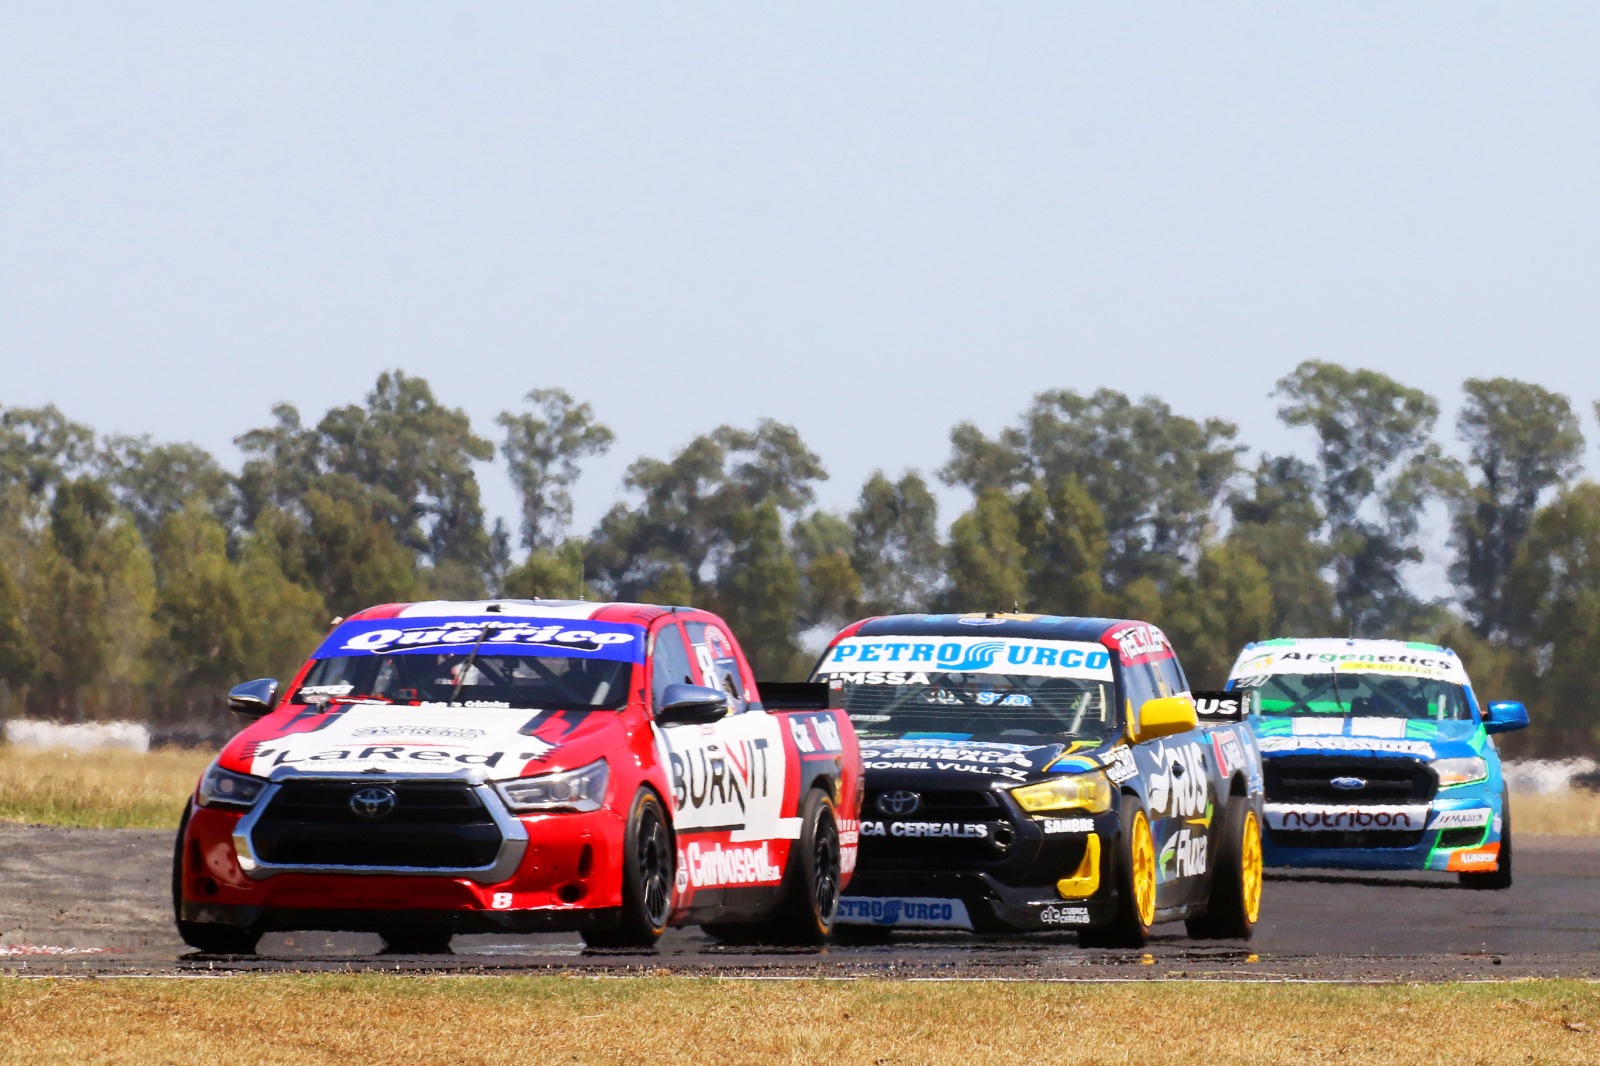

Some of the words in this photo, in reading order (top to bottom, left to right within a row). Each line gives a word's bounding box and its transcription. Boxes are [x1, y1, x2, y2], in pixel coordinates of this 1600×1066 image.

[340, 629, 484, 650] Que
[490, 626, 635, 645] rico
[831, 643, 963, 665] PETRO
[1280, 652, 1454, 670] Argenetics
[1192, 698, 1239, 715] US
[273, 747, 504, 767] LaRed
[936, 762, 1029, 782] VULLEZ
[1044, 818, 1095, 833] SAMBRE
[1283, 807, 1411, 827] nutribon
[890, 822, 988, 838] CEREALES
[492, 892, 513, 908] 8
[836, 900, 885, 918] ETRO
